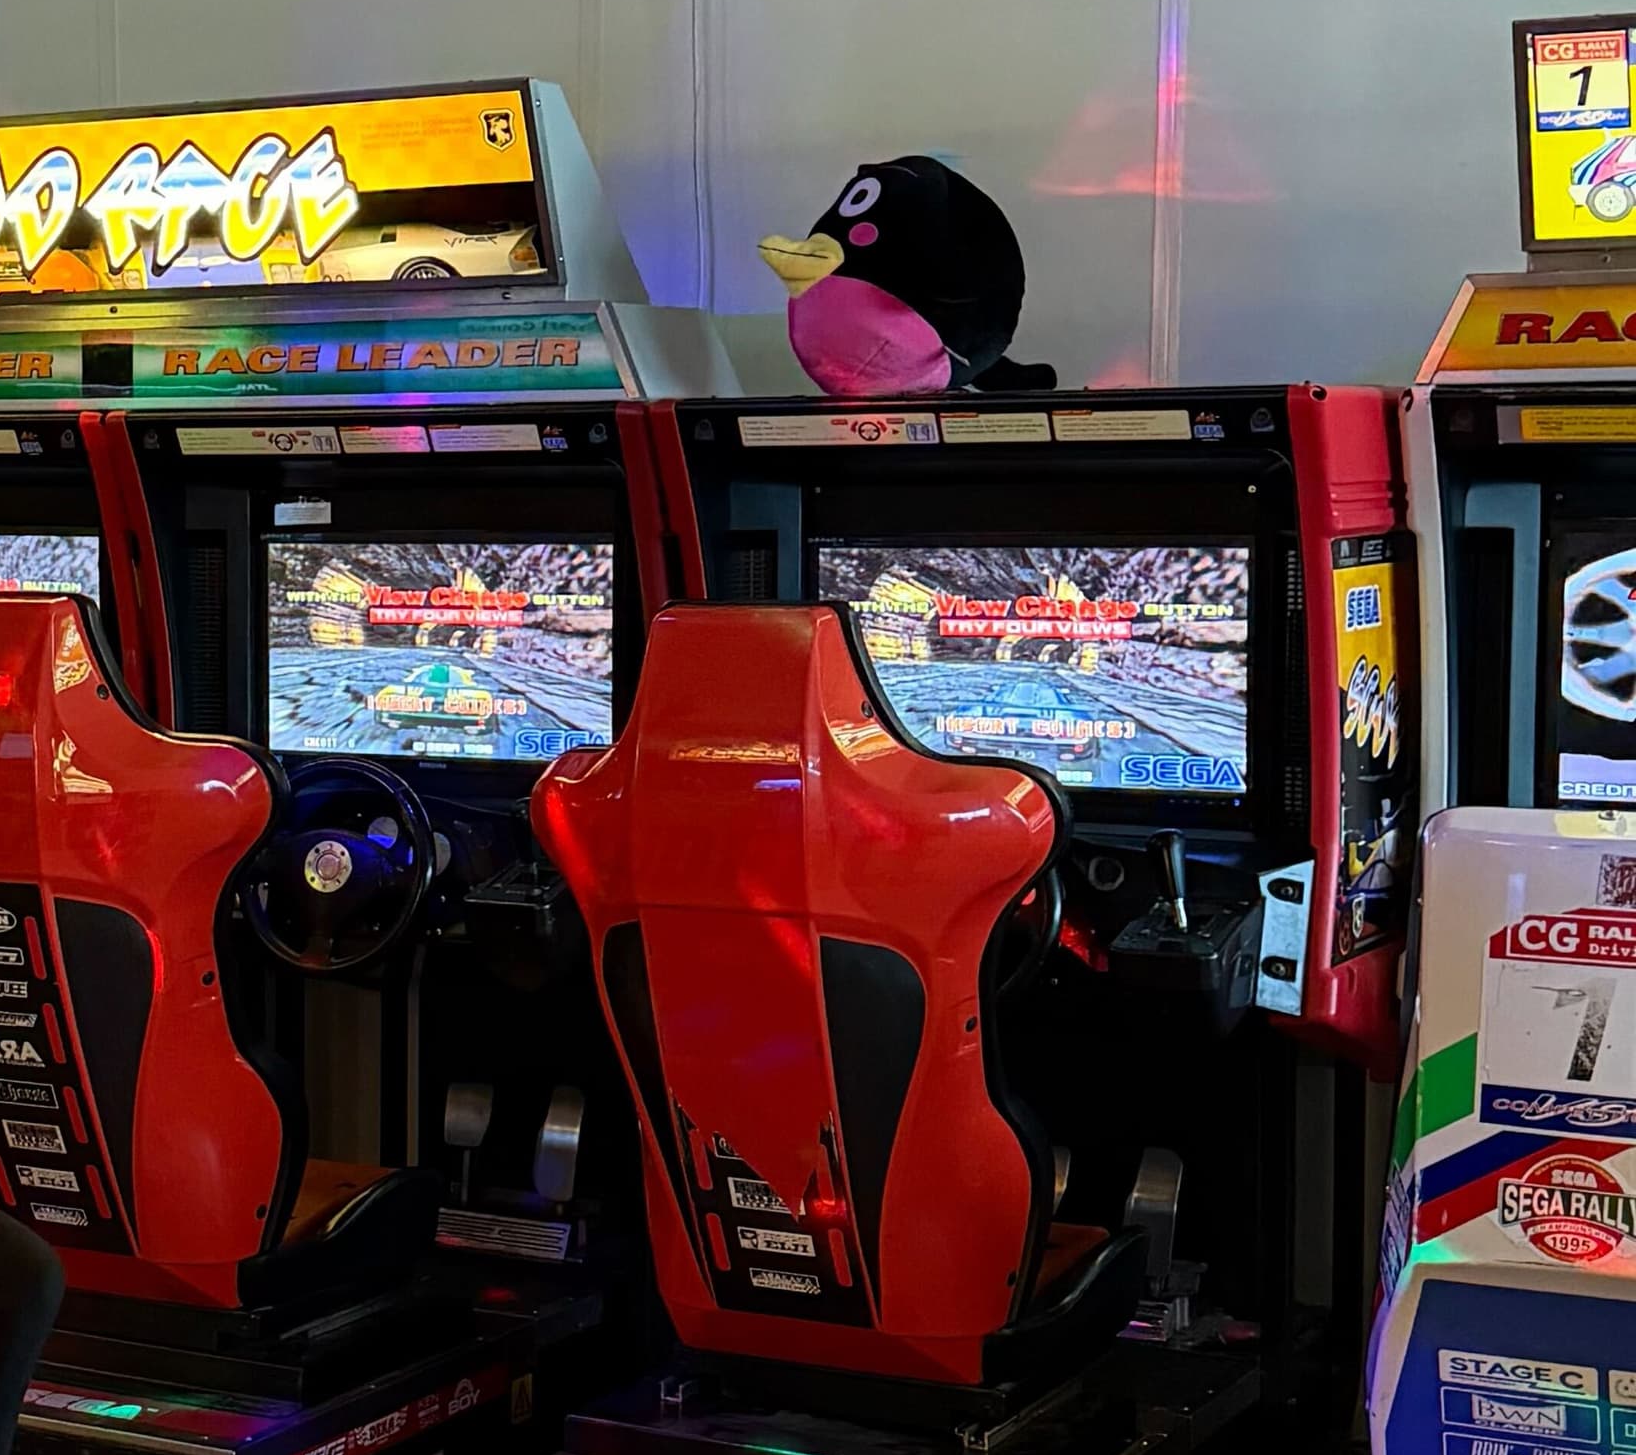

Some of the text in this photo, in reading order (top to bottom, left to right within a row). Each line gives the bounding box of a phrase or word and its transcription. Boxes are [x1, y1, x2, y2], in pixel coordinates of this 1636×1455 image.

[1544, 43, 1575, 60] CG
[1569, 65, 1593, 106] 1
[163, 337, 581, 376] RACE LEADER
[365, 587, 428, 607] View
[430, 587, 530, 609] Change
[532, 594, 605, 606] BUTTON
[933, 594, 1012, 618] View
[1015, 596, 1139, 620] Change
[1144, 604, 1234, 616] BUTTON
[1346, 585, 1382, 633] SEGA
[1120, 754, 1244, 789] SEGA
[1518, 919, 1581, 954] CG
[1551, 1169, 1598, 1189] SEGA
[1503, 1185, 1565, 1222] SEGA
[1550, 1236, 1592, 1252] 1995
[1450, 1357, 1584, 1390] STAGE C
[447, 1388, 481, 1416] BOY
[1478, 1399, 1561, 1427] BWN
